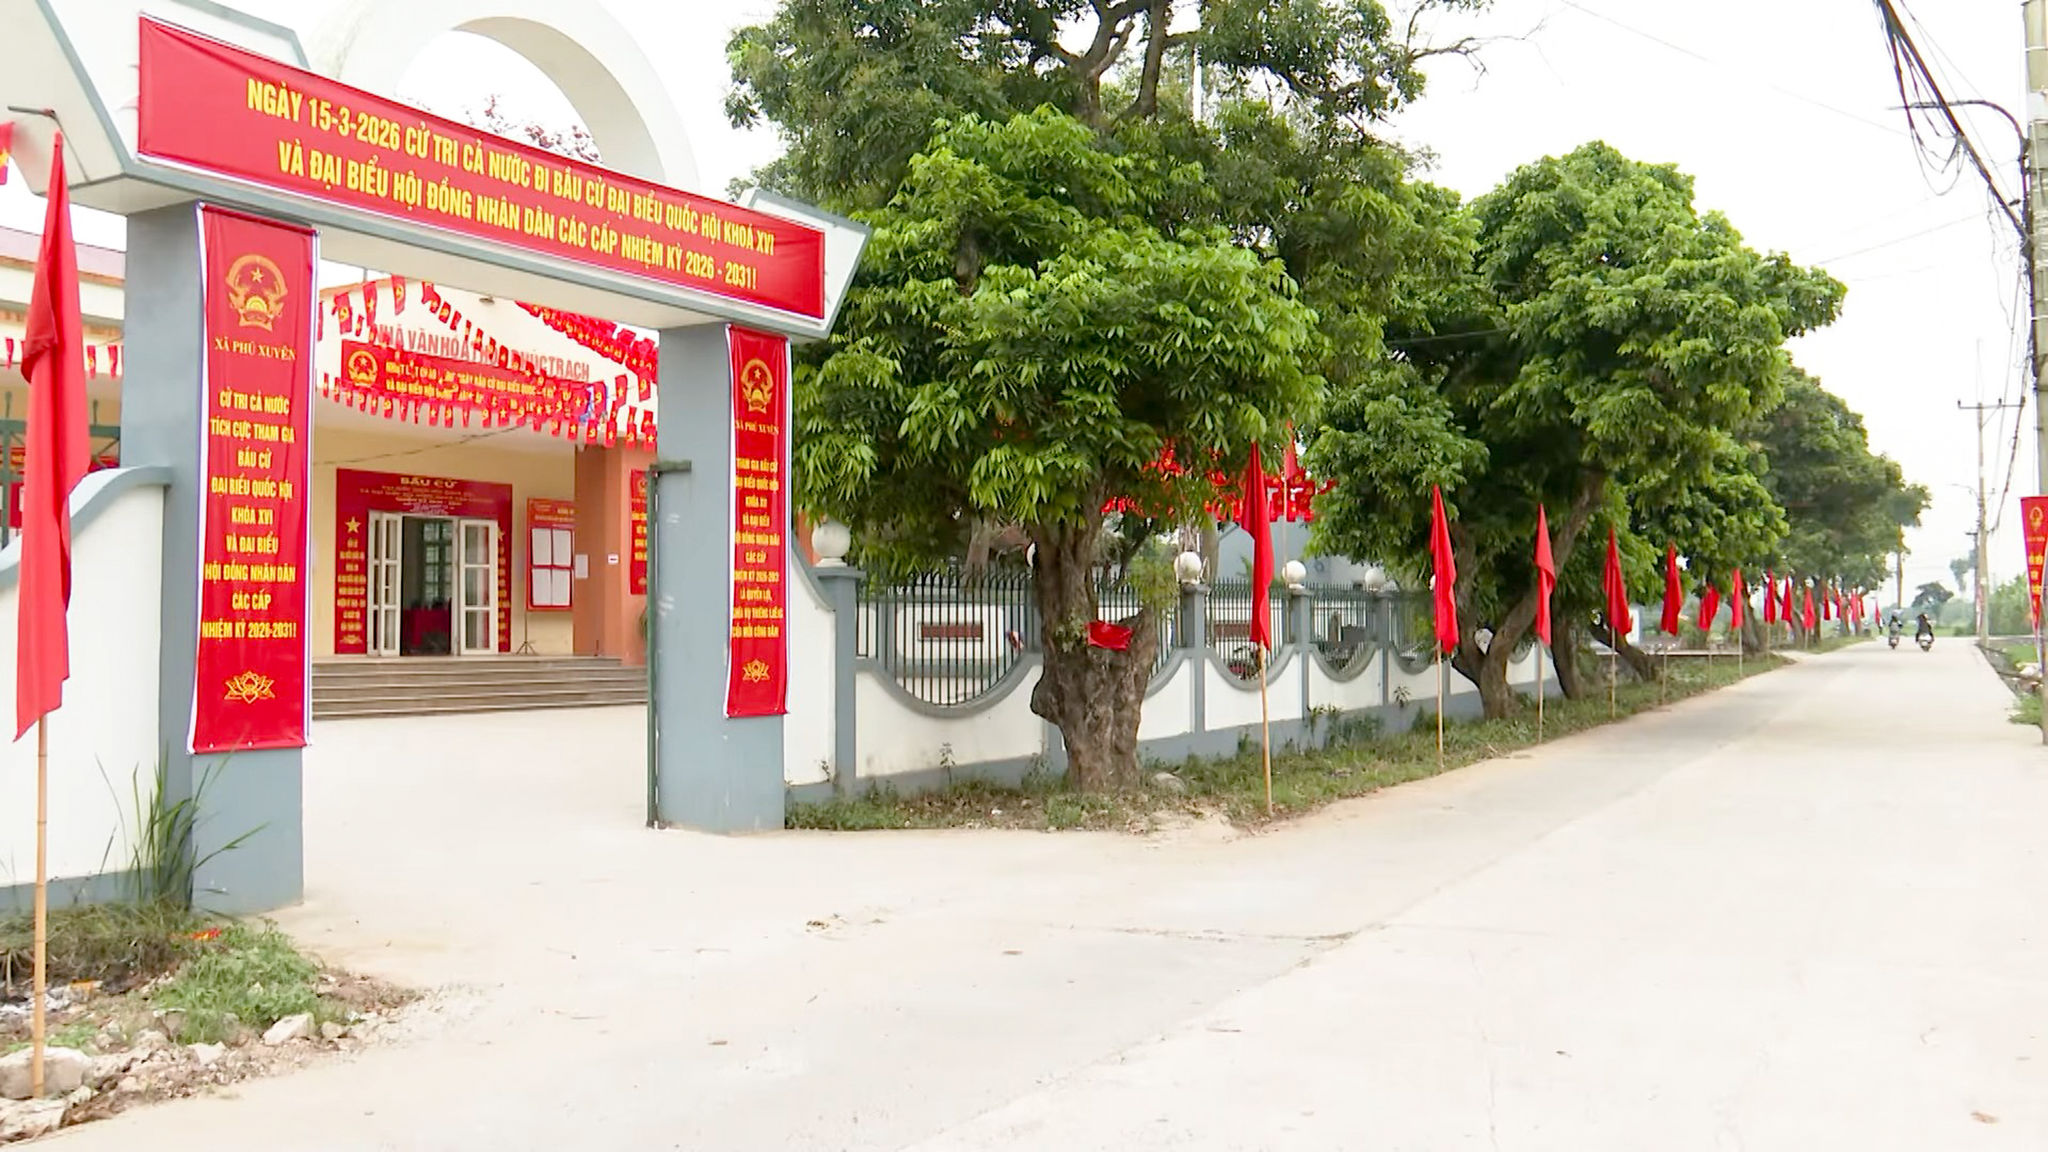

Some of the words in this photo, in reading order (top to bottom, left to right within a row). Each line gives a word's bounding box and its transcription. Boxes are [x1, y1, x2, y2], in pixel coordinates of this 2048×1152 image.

[247, 78, 303, 122] NGÀY
[308, 97, 401, 151] 15-3-2026
[405, 120, 430, 159] CỬ
[433, 134, 458, 167] TRI
[463, 139, 485, 175] CẢ
[488, 151, 531, 188] NƯỚC
[534, 164, 549, 193] ĐI
[553, 166, 582, 202] BẦU
[585, 175, 606, 208] CỬ
[608, 187, 630, 220] ĐẠI
[634, 190, 662, 224] BIỂU
[665, 201, 698, 234] QUỐC
[701, 212, 721, 244] HỘI
[756, 231, 775, 256] XVI
[278, 138, 304, 177] VÀ
[309, 149, 342, 191] ĐẠI
[347, 154, 388, 198] BIỂU
[393, 170, 422, 212] HỘI
[426, 177, 472, 220] ĐỒNG
[476, 195, 520, 231] NHÂN
[524, 205, 555, 240] DÂN
[559, 215, 587, 248] CÁC
[591, 220, 618, 255] CẤP
[621, 234, 663, 269] NHIỆM
[667, 242, 683, 272] KỲ
[685, 251, 715, 280] 2026
[725, 261, 757, 290] 2031!
[214, 336, 229, 352] XÃ
[232, 340, 255, 356] PHÚ
[258, 344, 296, 360] XUYÊN
[219, 386, 232, 408] CỬ
[234, 392, 248, 409] TRI
[250, 389, 263, 412] CẢ
[210, 416, 231, 437] TÍCH
[232, 421, 251, 441] CỰC
[253, 423, 279, 441] THAM
[281, 426, 295, 443] GIA
[237, 445, 257, 467] BẦU
[258, 447, 272, 469] CỬ
[211, 476, 228, 496] ĐẠI
[229, 473, 250, 495] BIỂU
[252, 475, 277, 498] QUỐC
[279, 480, 293, 502] HỘI
[258, 508, 273, 525] XVI
[226, 532, 238, 552] VÀ
[239, 536, 255, 556] ĐẠI
[256, 531, 279, 554] BIỂU
[205, 560, 221, 584] HỘI
[223, 559, 248, 581] ĐỒNG
[250, 562, 276, 582] NHÂN
[277, 562, 296, 582] DÂN
[232, 590, 250, 610] CÁC
[251, 588, 271, 610] CẤP
[202, 617, 233, 642] NHIỆM
